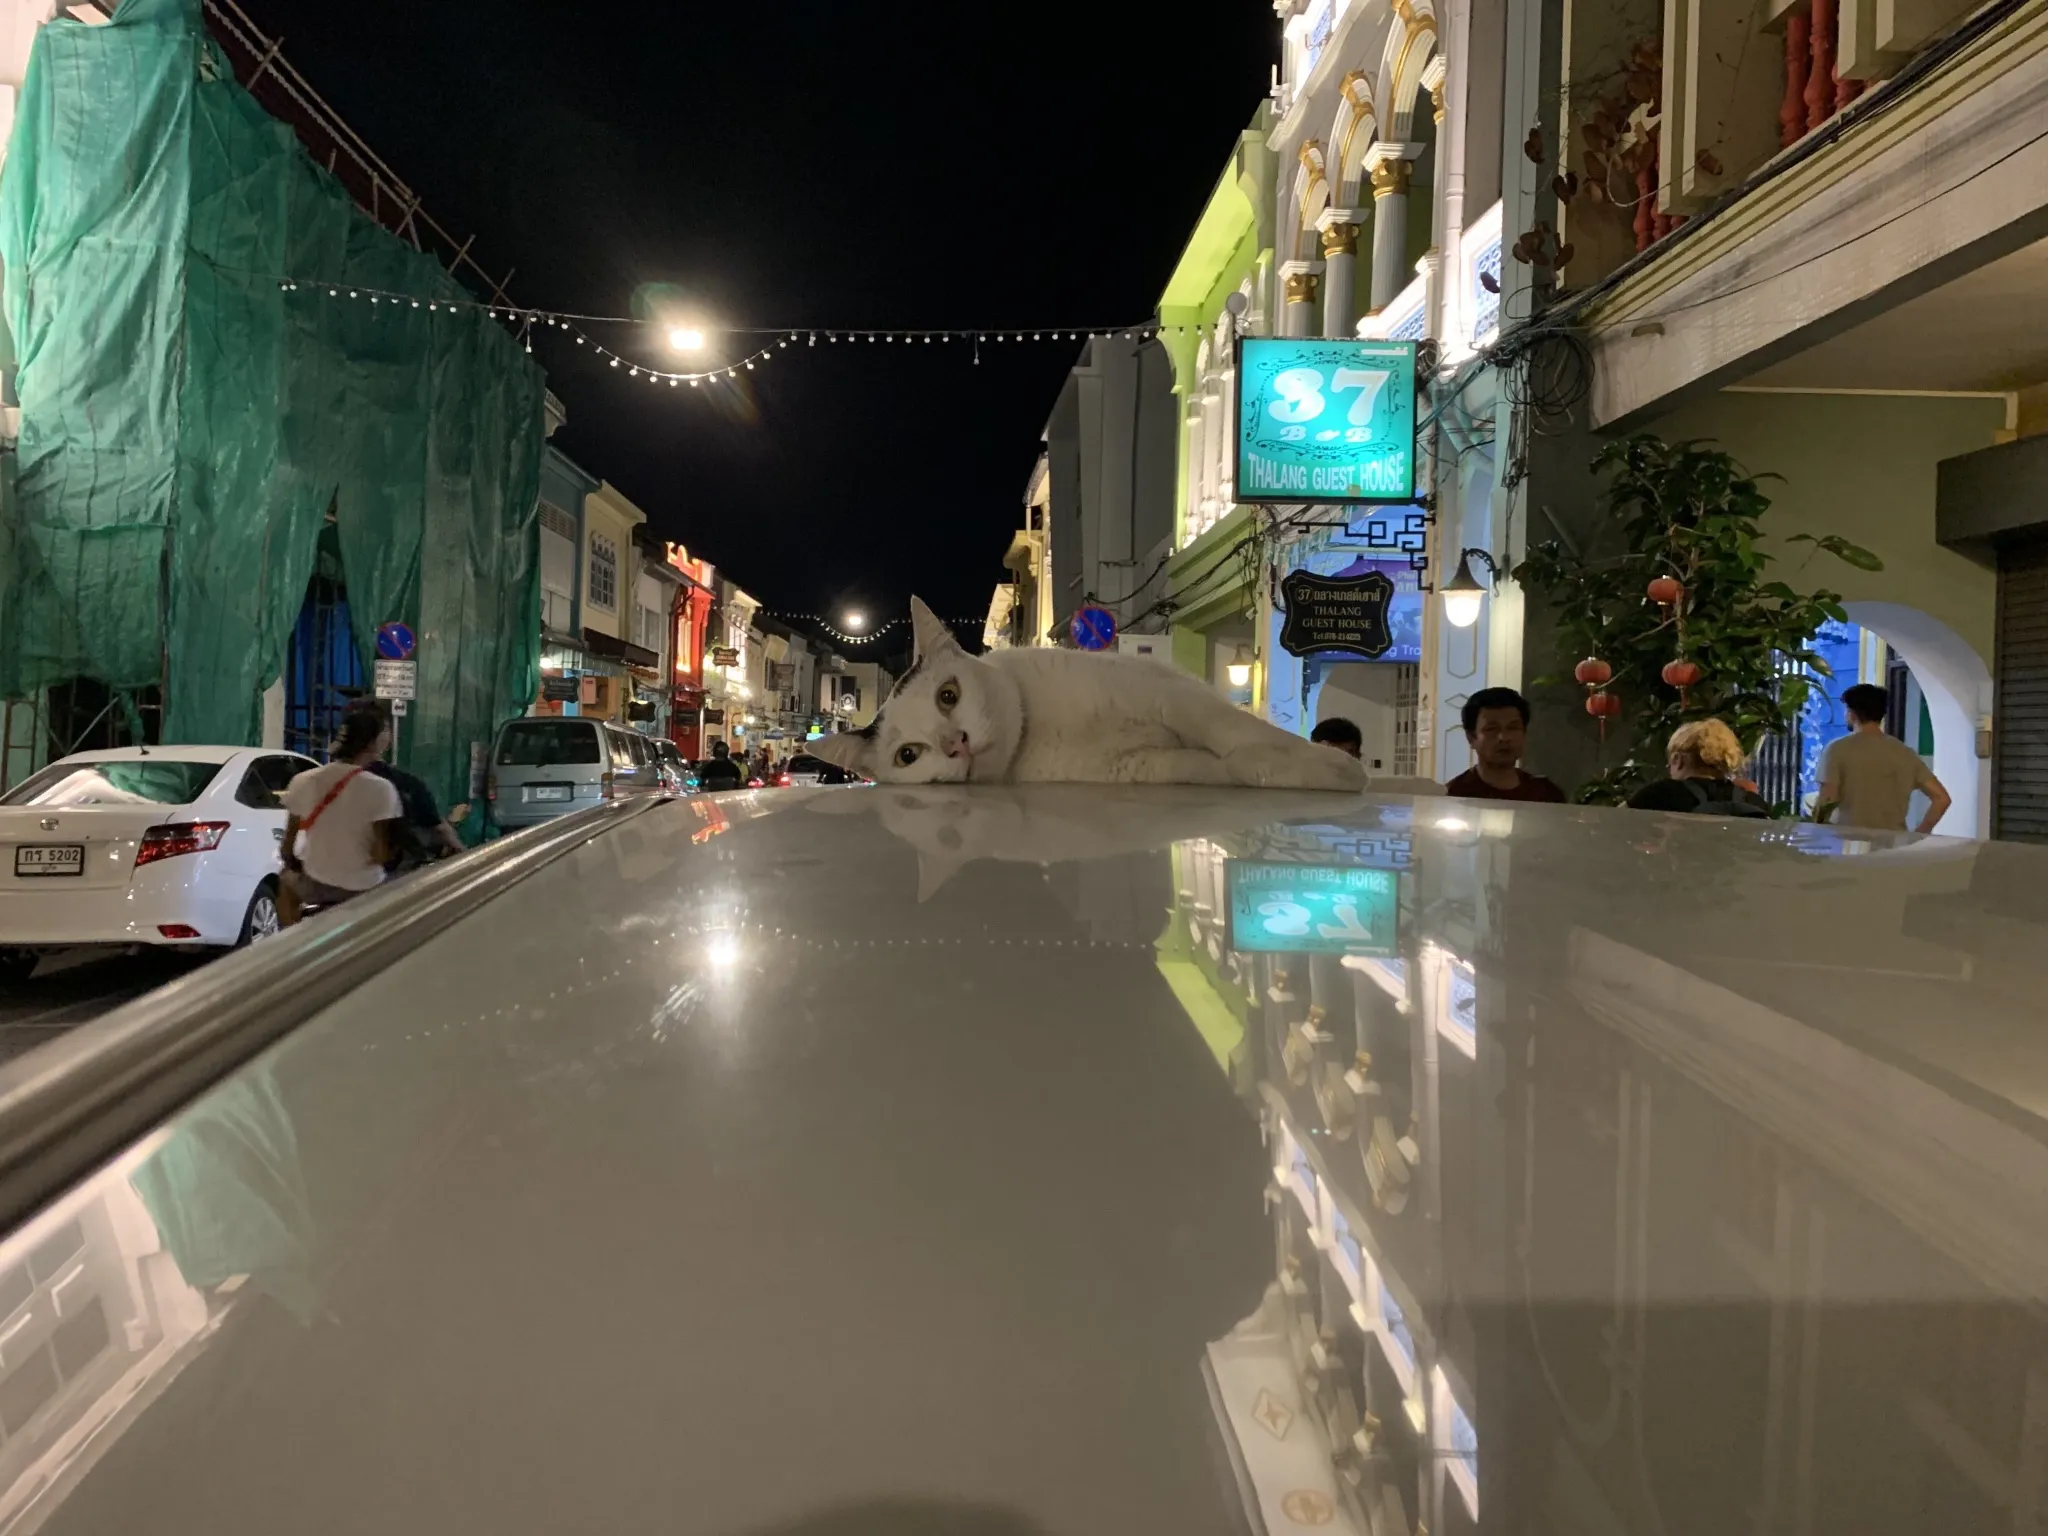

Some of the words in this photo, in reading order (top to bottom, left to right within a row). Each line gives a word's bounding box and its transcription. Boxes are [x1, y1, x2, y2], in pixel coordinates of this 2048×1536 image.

[1268, 367, 1391, 426] 37
[1247, 452, 1307, 490] THALANG
[1312, 465, 1356, 490] GUEST
[1359, 451, 1405, 492] HOUSE
[1298, 588, 1311, 601] 37
[1313, 605, 1362, 617] THALANG
[1302, 618, 1336, 629] GUEST
[1338, 618, 1372, 630] HOUSE
[48, 849, 79, 862] 5202
